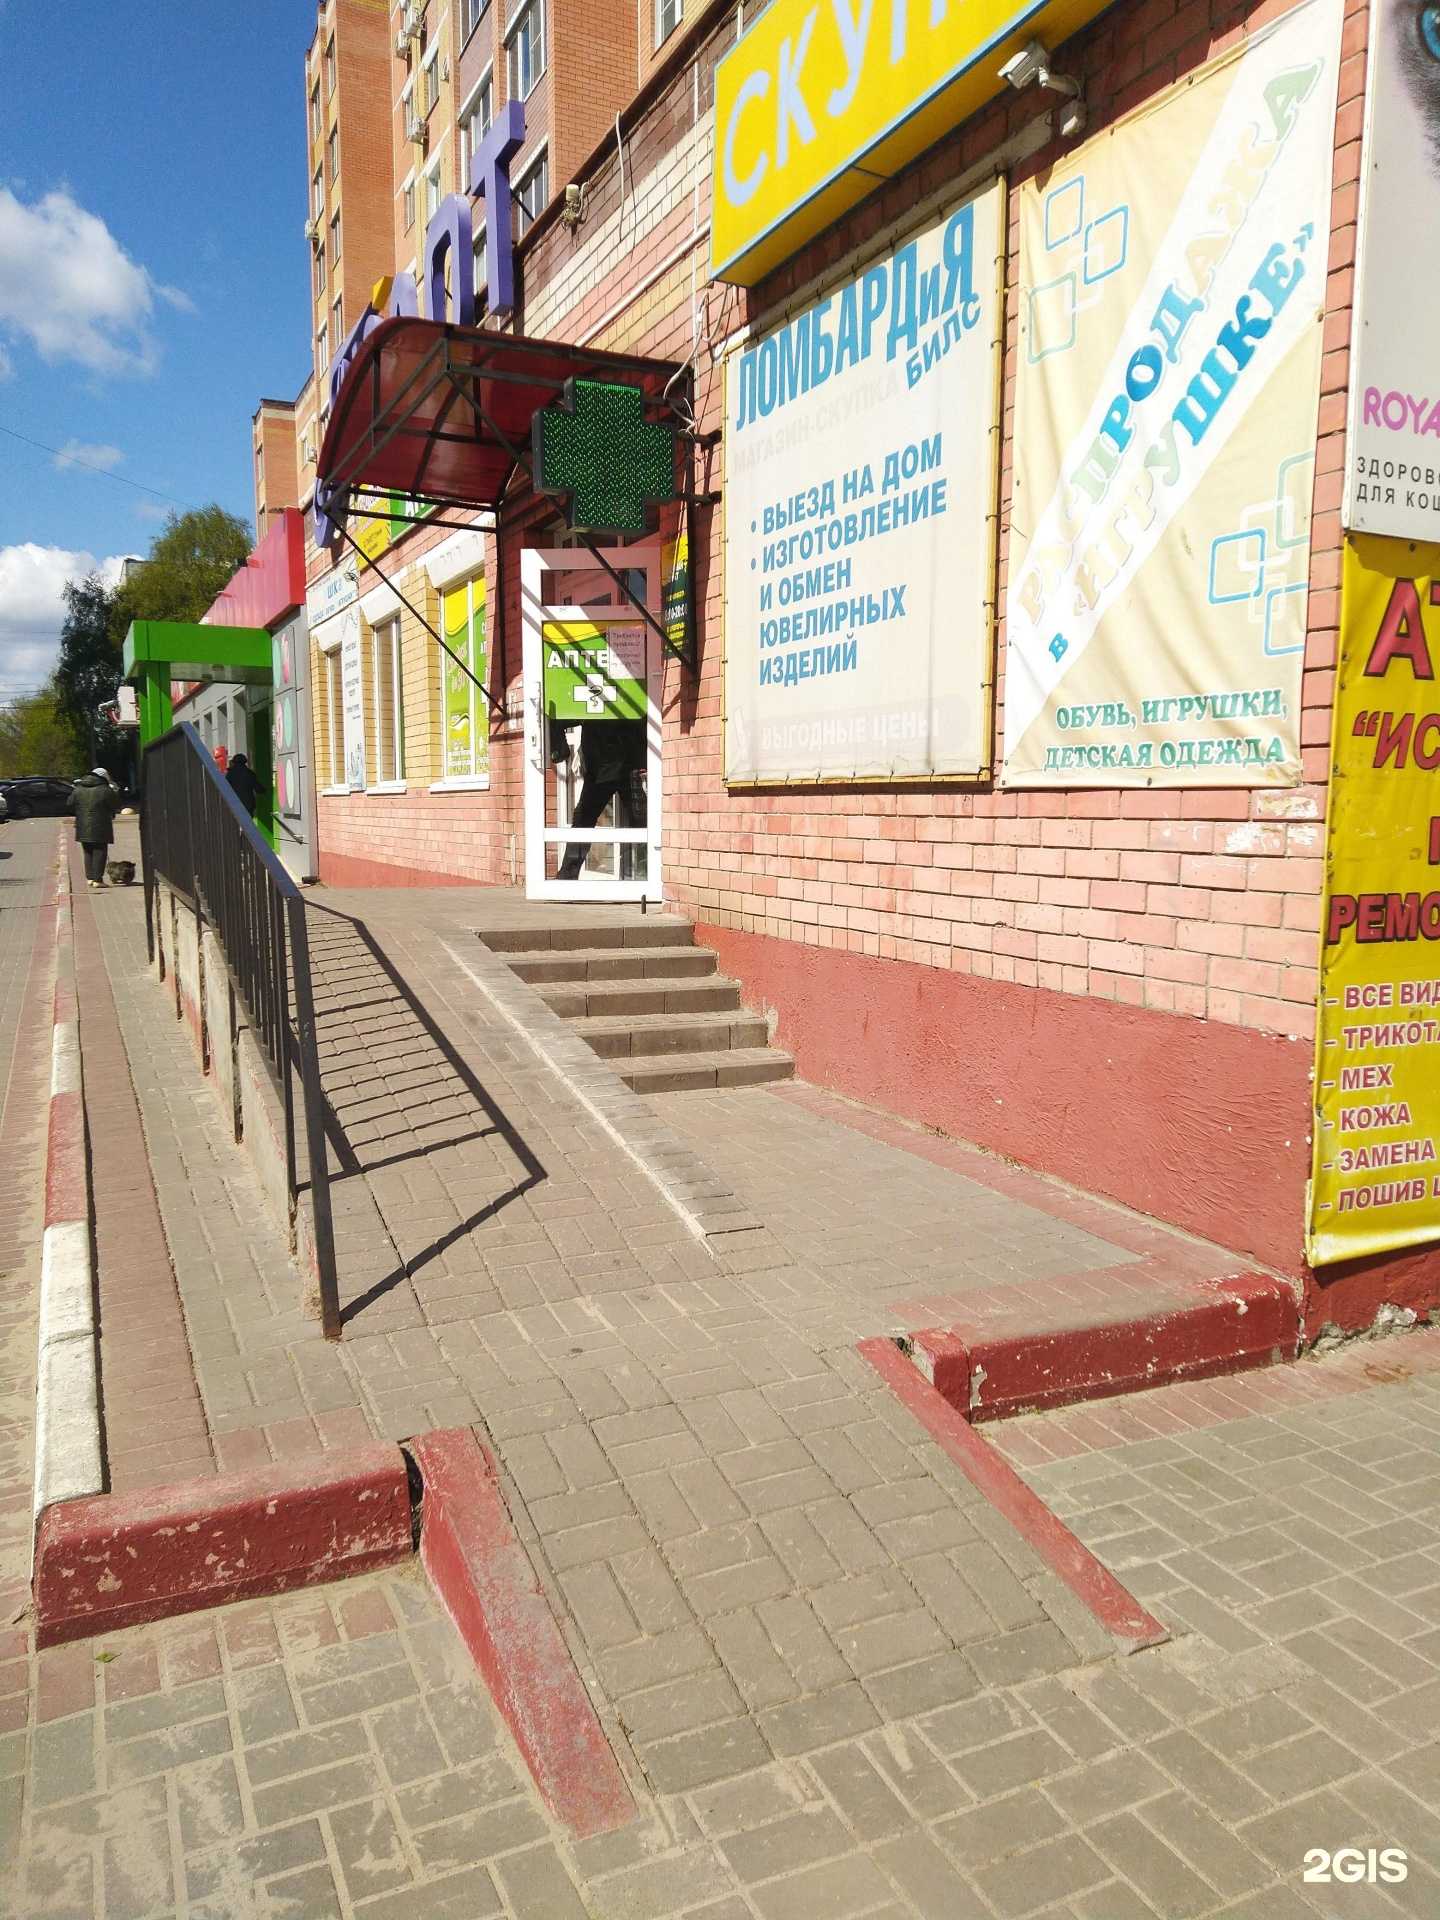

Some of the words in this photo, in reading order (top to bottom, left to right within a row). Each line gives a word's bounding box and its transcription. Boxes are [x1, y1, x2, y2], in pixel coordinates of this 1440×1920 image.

[905, 293, 981, 390] БИЛС
[763, 479, 836, 535] ВЫЕЗД
[843, 463, 874, 504] НА
[882, 432, 943, 495] ДОМ
[1357, 456, 1440, 485] ЗДОРОВ
[1356, 483, 1396, 505] ДЛЯ
[763, 477, 948, 573] ИЗГОТОВЛЕНИЕ
[760, 583, 773, 612] И
[778, 557, 852, 607] ОБМЕН
[760, 584, 908, 649] ЮВЕЛИРНЫХ
[759, 631, 858, 687] ИЗДЕЛИЙ
[1056, 702, 1138, 730] ОБУВЬ,
[1142, 689, 1288, 724] ИГРУШКИ,
[1044, 743, 1153, 773] ДЕТСКАЯ
[1160, 737, 1287, 769] ОДЕЖДА
[1345, 983, 1393, 1010] ВСЕ
[1341, 1064, 1394, 1092] МЕХ
[1340, 1101, 1412, 1132] КОЖА
[1340, 1138, 1437, 1174] ЗАМЕНА
[1337, 1178, 1426, 1212] ПОШИВ
